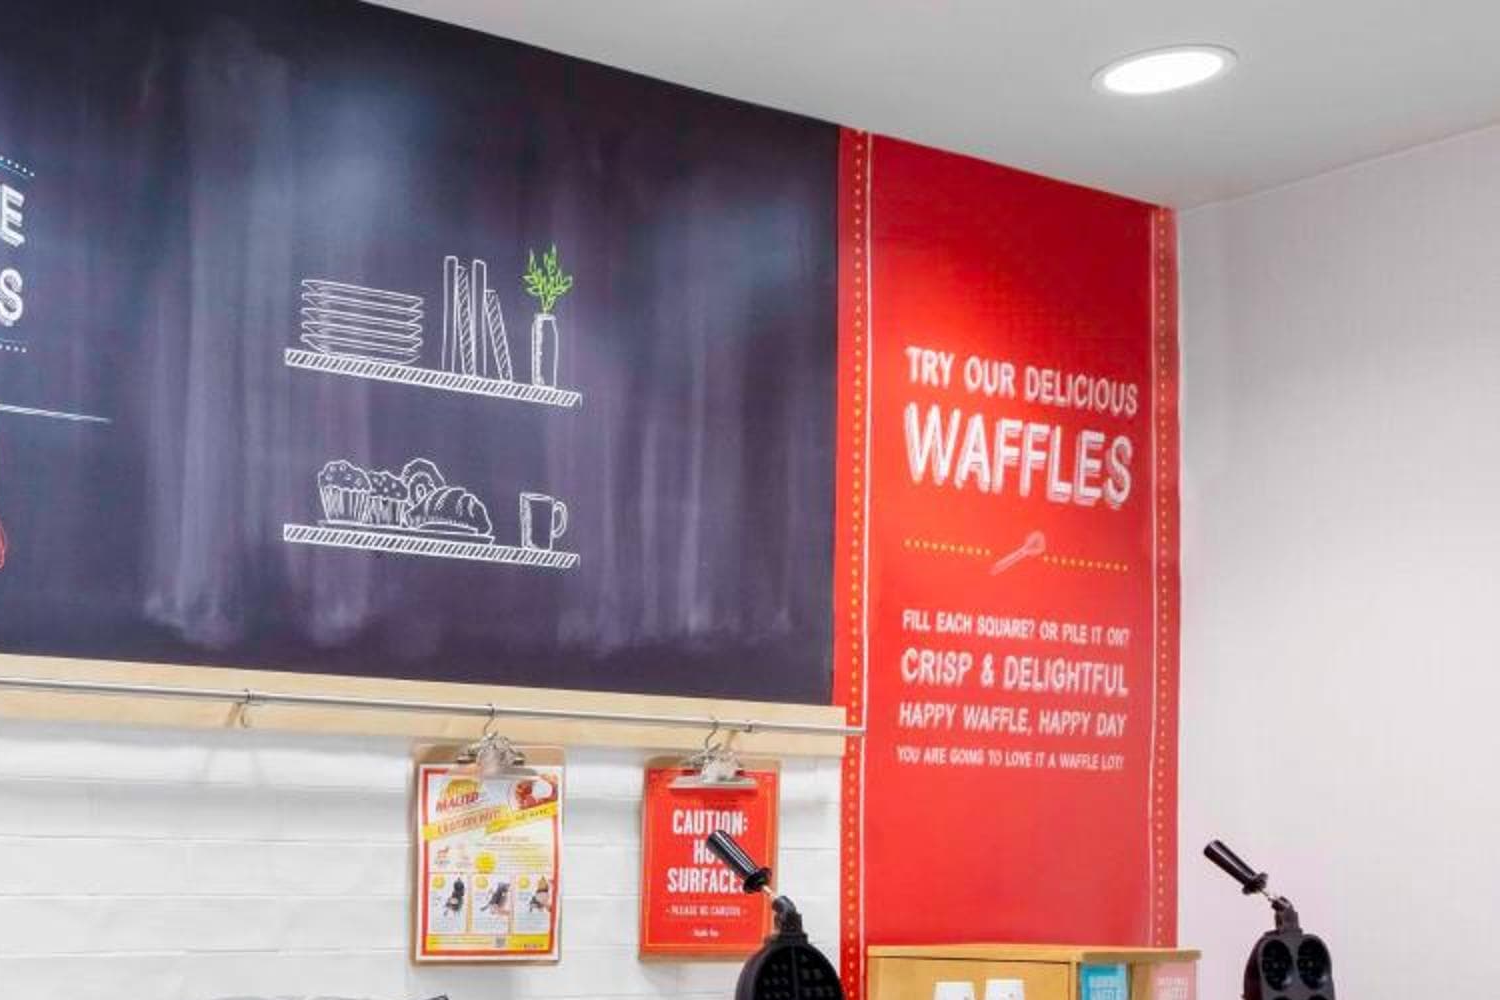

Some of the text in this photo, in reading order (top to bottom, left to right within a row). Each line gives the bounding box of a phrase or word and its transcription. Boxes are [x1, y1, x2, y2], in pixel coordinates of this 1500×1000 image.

[904, 346, 1138, 416] TRY OUR DELICIOUS
[904, 402, 1133, 510] WAFFLES
[902, 608, 931, 632] FILL
[936, 611, 972, 634] EACH
[977, 615, 1034, 640] SQUARE?
[1040, 620, 1058, 641] OR
[1062, 623, 1088, 645] PILE
[1092, 625, 1103, 646] IT
[901, 647, 1128, 697] CRISP & DELIGHTFUL
[899, 701, 1127, 738] HAPPY WAFFLE, HAPPY DAY
[896, 745, 920, 764] YOU
[924, 747, 947, 765] ARE
[949, 747, 984, 766] GOING
[988, 749, 1003, 767] TO
[1005, 751, 1032, 768] LOVE
[1036, 751, 1045, 768] IT
[1048, 752, 1057, 768] A
[1060, 752, 1099, 770] WAFFLE
[672, 808, 749, 835] CAUTION:
[693, 838, 726, 864] HO
[667, 868, 746, 893] SURFACE
